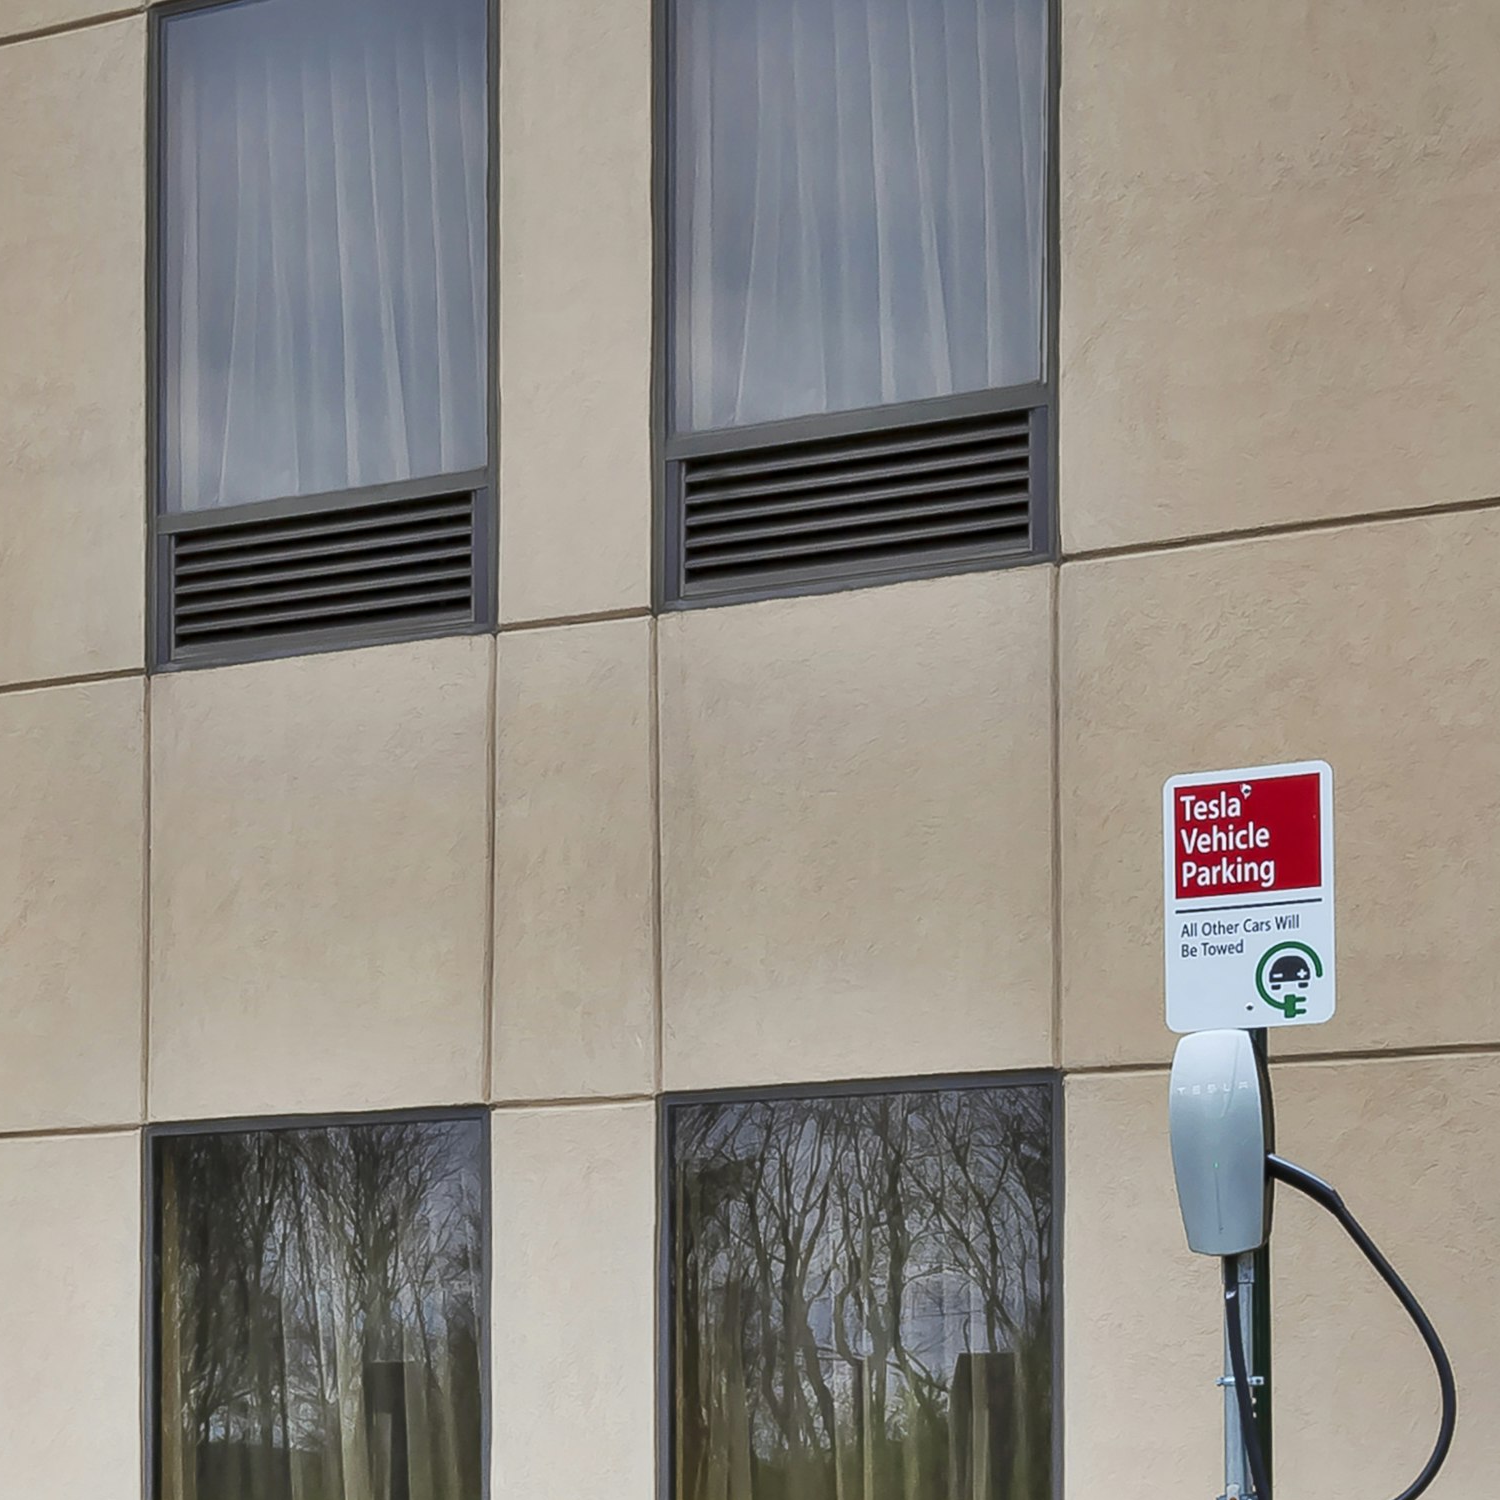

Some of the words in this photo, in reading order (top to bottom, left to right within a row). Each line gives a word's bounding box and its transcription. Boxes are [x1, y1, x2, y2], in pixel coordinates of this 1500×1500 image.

[1180, 790, 1241, 821] Tesla
[1180, 821, 1270, 854] Vehicle
[1182, 856, 1275, 888] Parking
[1180, 922, 1197, 938] All
[1201, 920, 1240, 936] Other
[1243, 918, 1271, 933] Cars
[1274, 914, 1299, 930] Will
[1181, 943, 1198, 958] Be
[1201, 938, 1244, 956] Towed
[1176, 1081, 1248, 1095] TESLA
